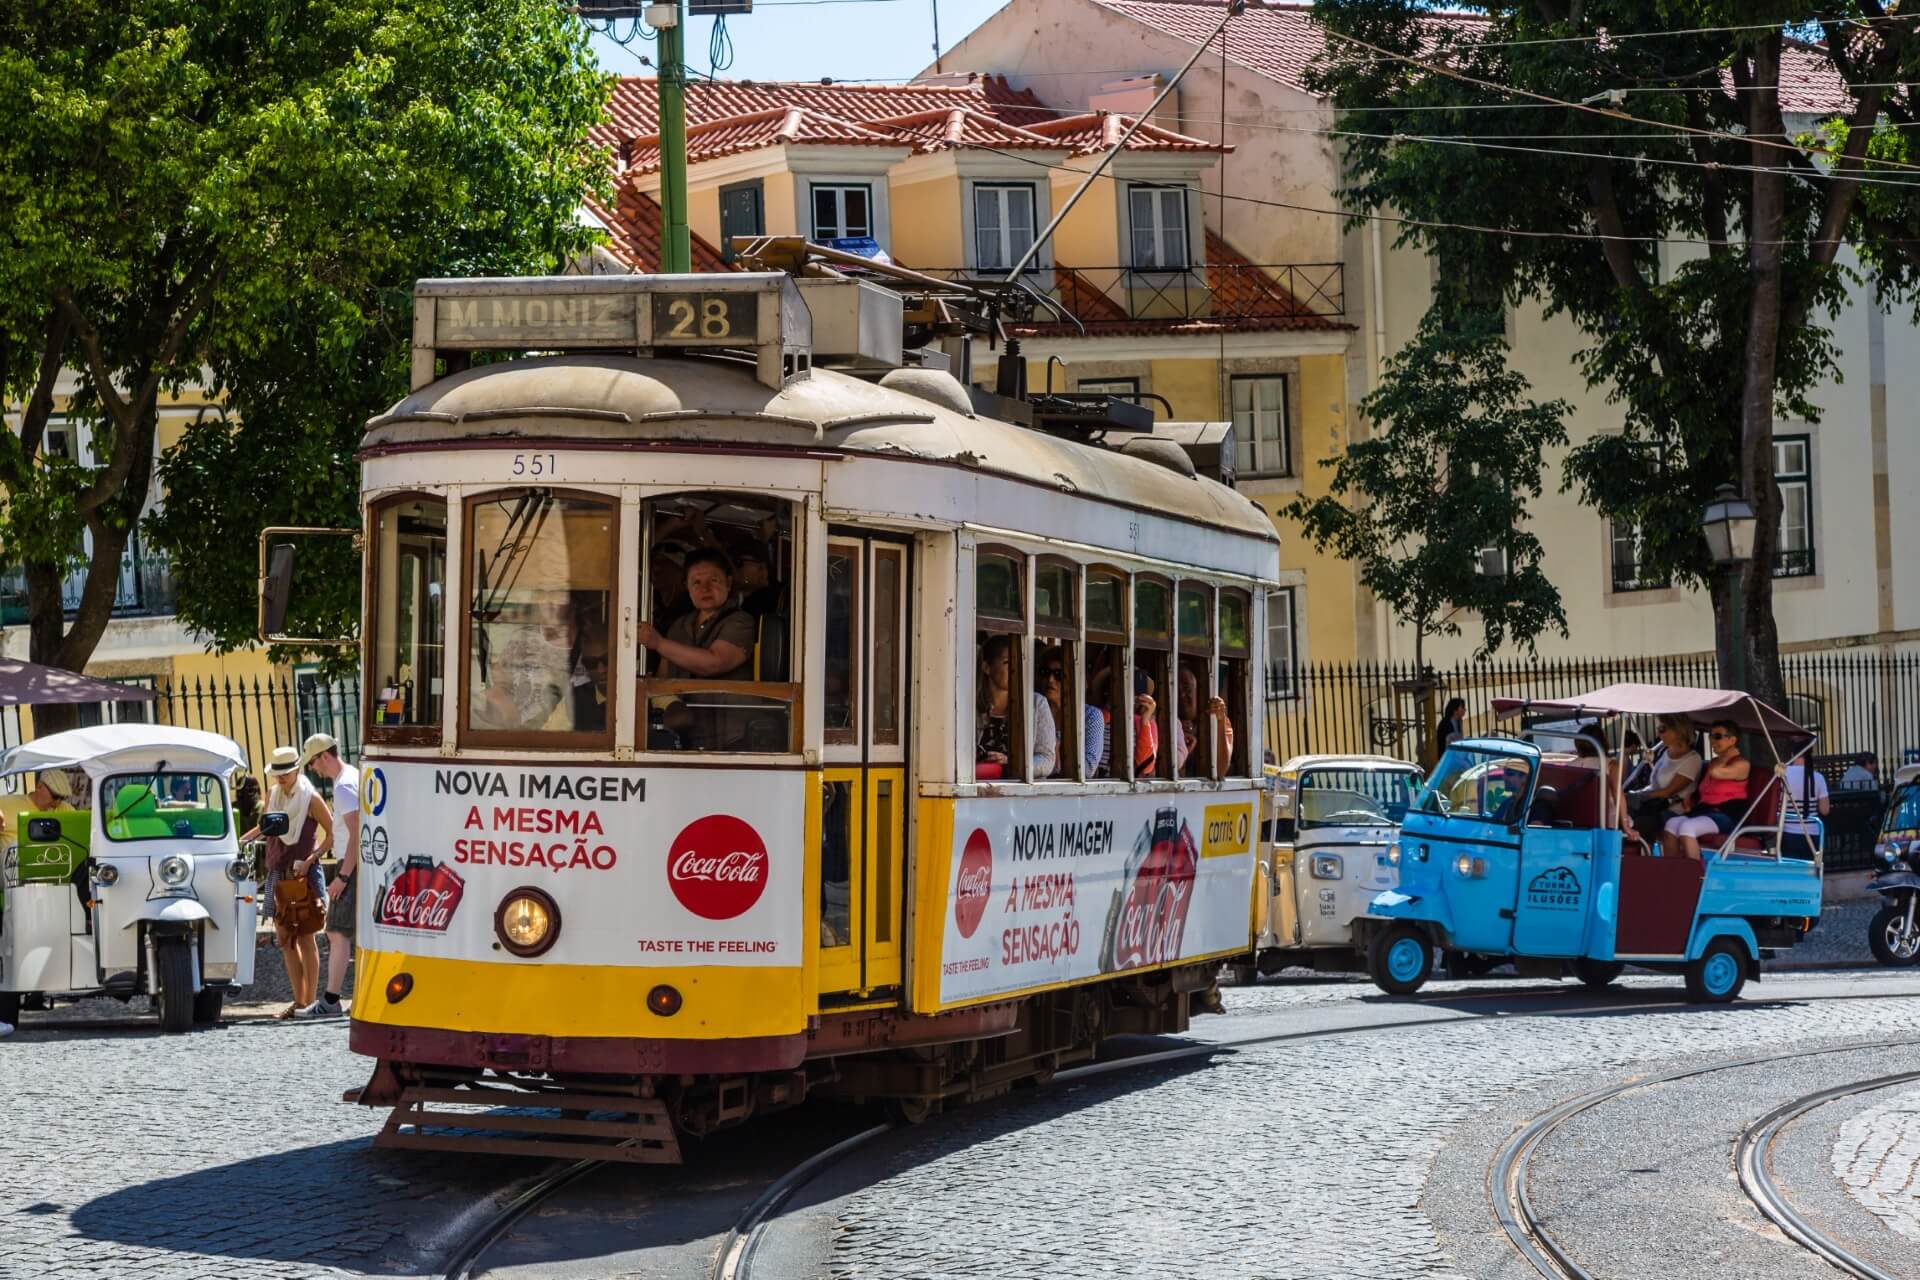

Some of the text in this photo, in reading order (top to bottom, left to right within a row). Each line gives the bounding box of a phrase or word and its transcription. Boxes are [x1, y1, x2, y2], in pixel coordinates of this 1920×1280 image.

[492, 298, 617, 327] MONIZ
[668, 298, 731, 339] 28
[512, 454, 556, 475] 551
[435, 770, 647, 802] NOVA IMAGEM
[464, 805, 604, 836] A MESMA
[454, 838, 617, 873] SENSAÇÃO
[1012, 820, 1114, 862] NOVA IMAGEM
[672, 850, 765, 882] Coca-Cola
[1004, 871, 1074, 914] A MESMA
[638, 939, 776, 953] TASTE THE FEELING
[1001, 911, 1080, 966] SENSAÇÃO
[943, 961, 959, 976] TASTE
[959, 960, 969, 973] THE
